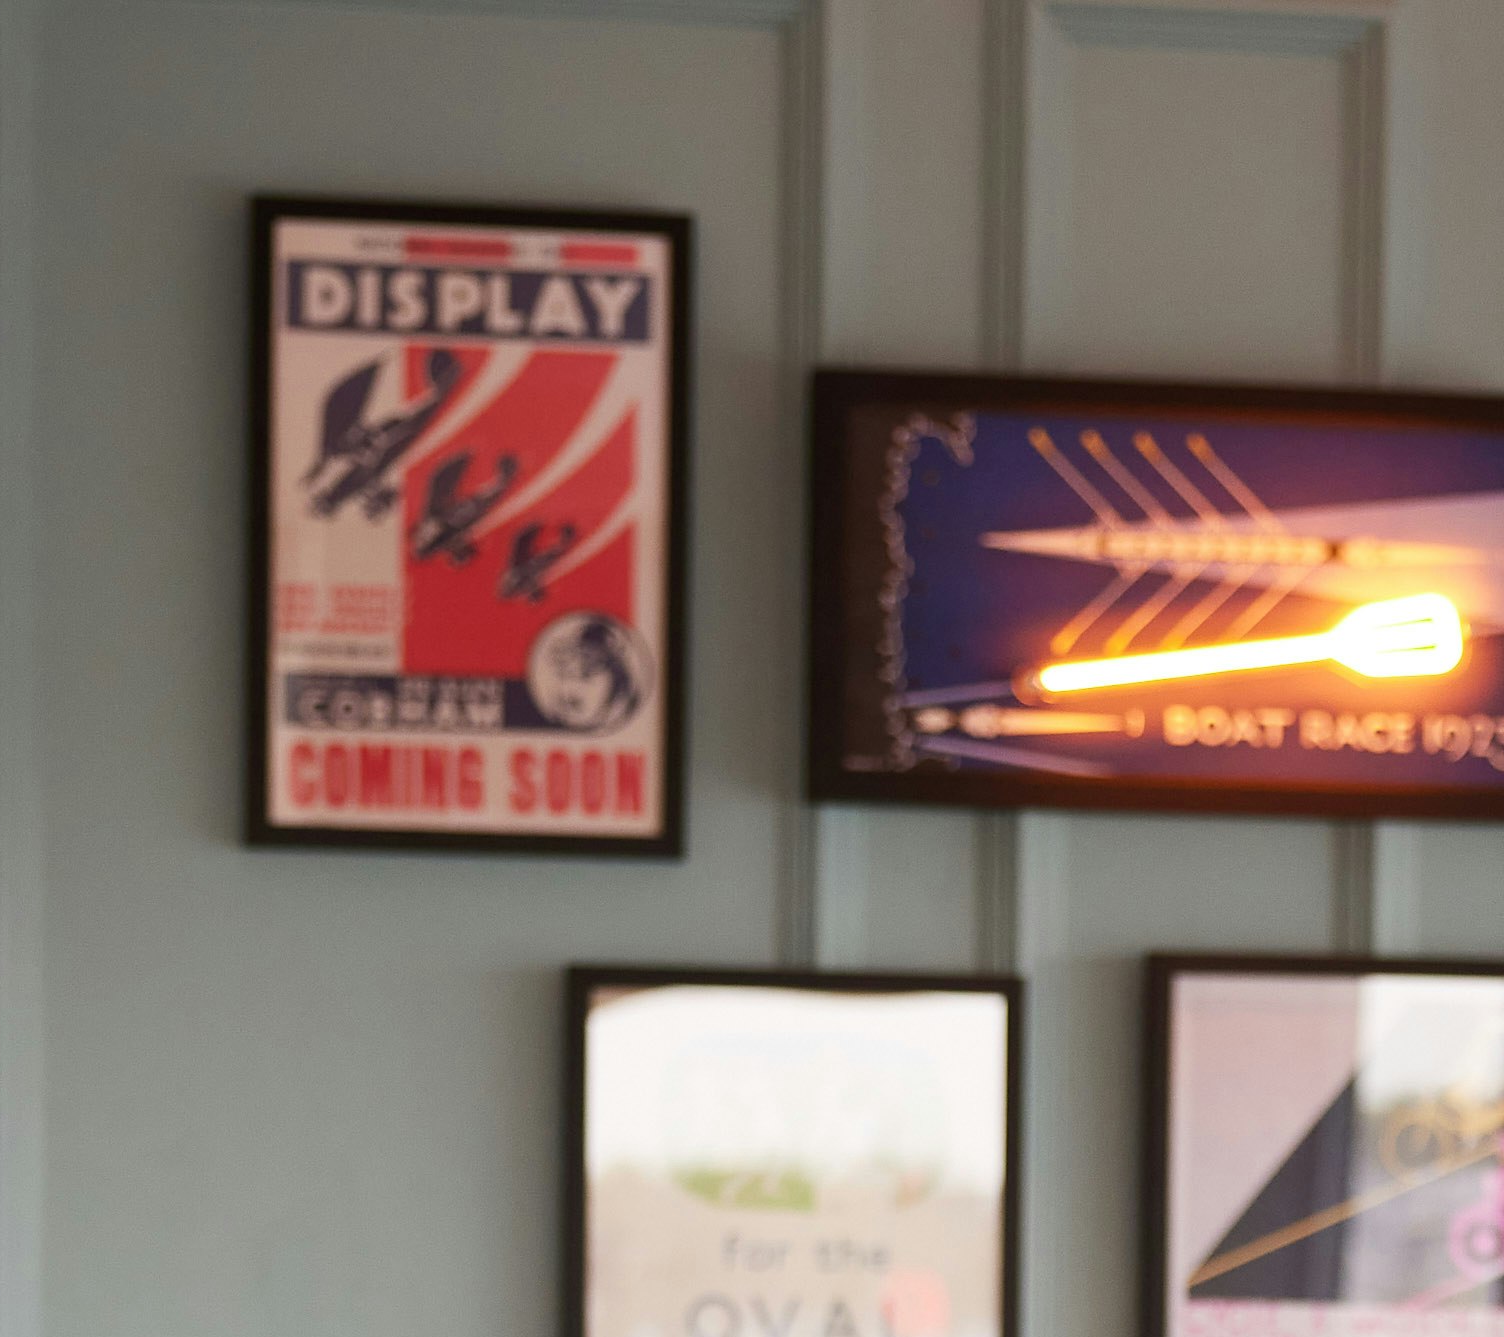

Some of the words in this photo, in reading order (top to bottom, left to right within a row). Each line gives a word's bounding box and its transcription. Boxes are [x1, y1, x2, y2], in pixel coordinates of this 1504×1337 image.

[302, 265, 640, 337] DISPLAY
[1163, 704, 1295, 748] BOAT
[1301, 709, 1414, 754] RACE
[291, 742, 486, 813] COMING
[511, 748, 647, 817] SOON
[722, 1236, 792, 1273] for
[814, 1237, 893, 1273] the
